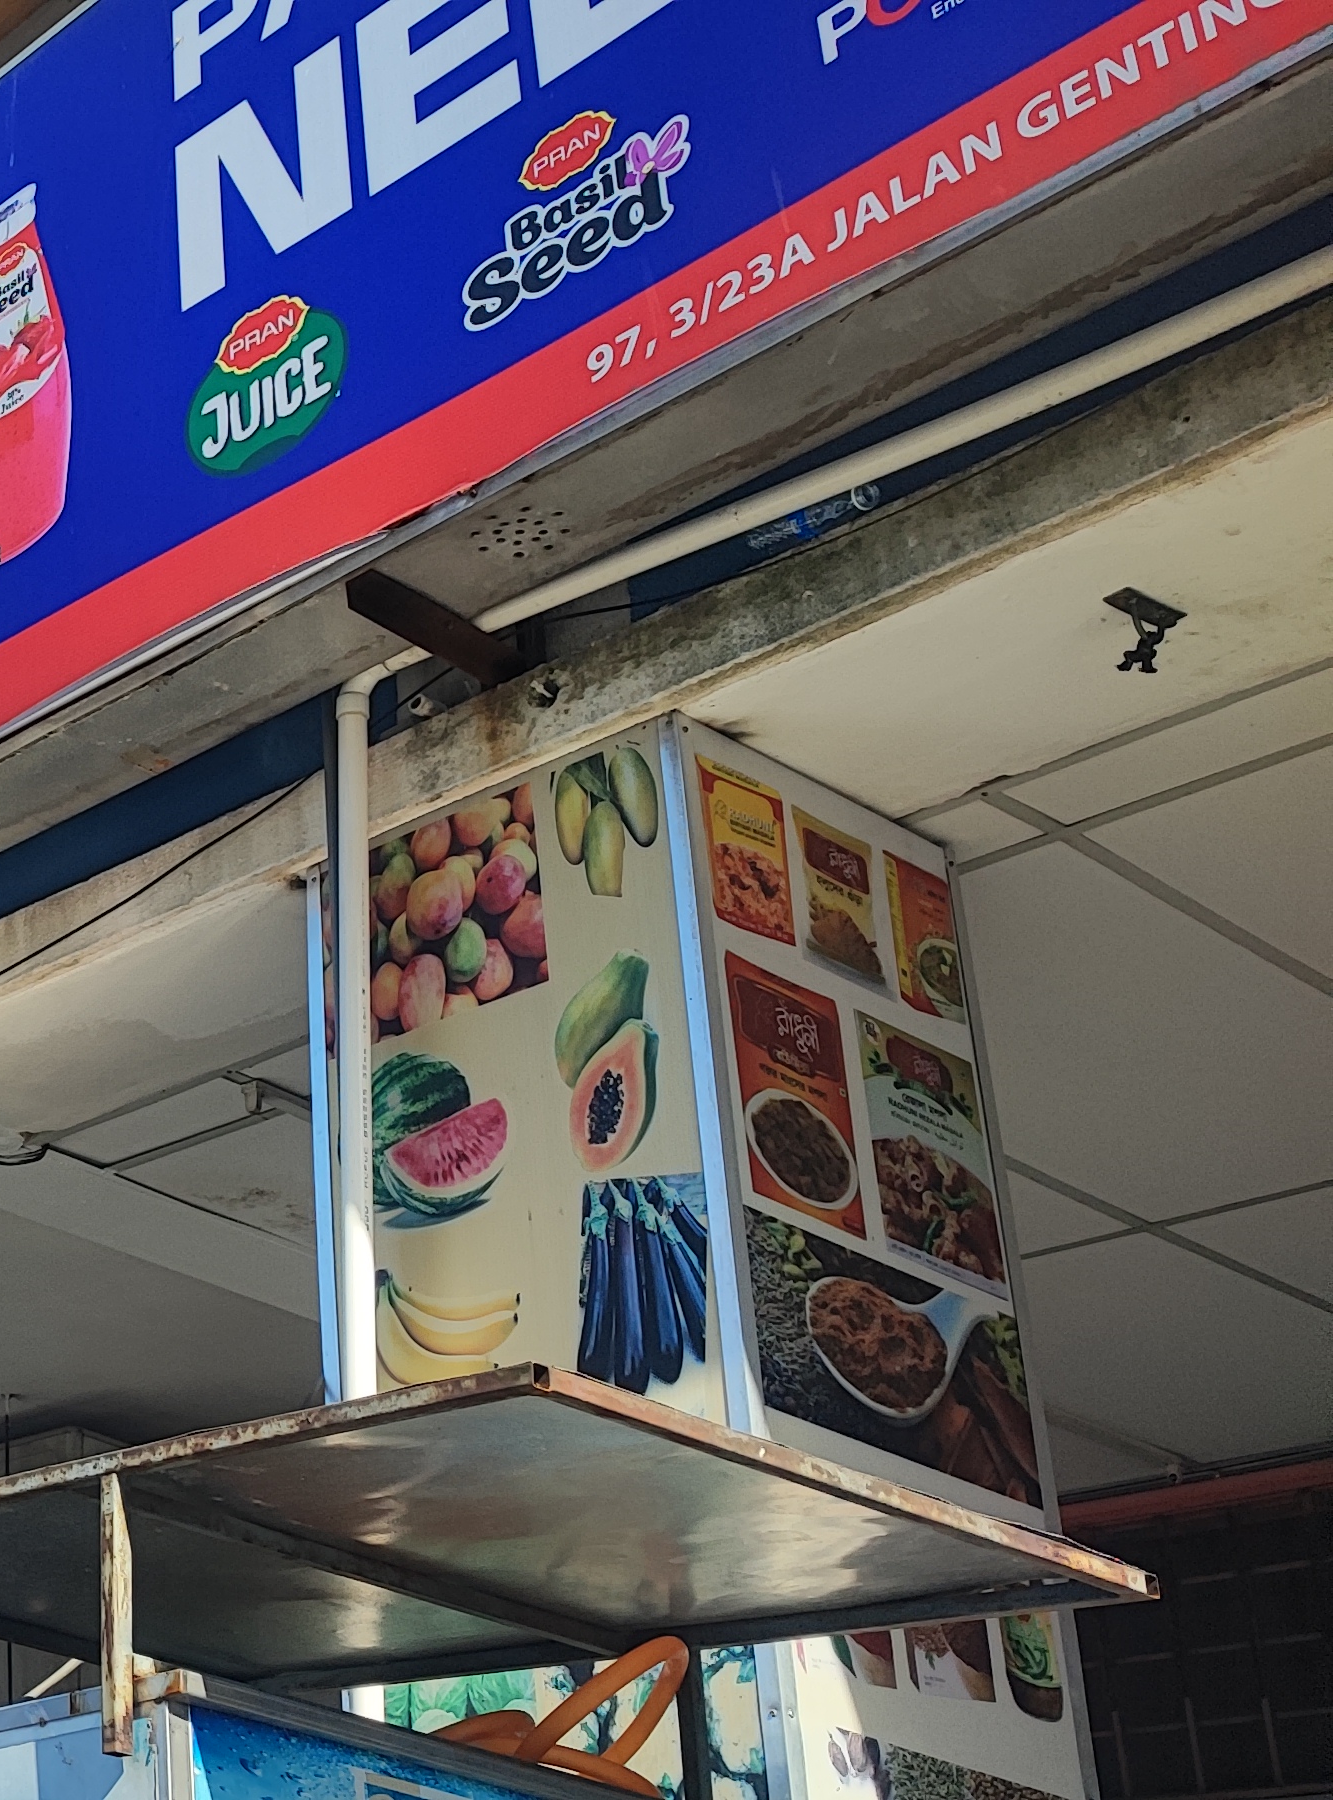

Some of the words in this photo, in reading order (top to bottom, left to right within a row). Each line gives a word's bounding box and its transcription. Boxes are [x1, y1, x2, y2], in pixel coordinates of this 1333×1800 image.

[509, 155, 629, 251] Basil
[533, 123, 601, 178] PRAN
[586, 327, 657, 383] 97,
[669, 233, 815, 338] 3/23A
[827, 121, 1003, 252] JALAN
[1017, 0, 1284, 138] GENTIN
[467, 170, 668, 325] Seed
[228, 309, 295, 360] PRAN
[200, 334, 332, 459] JUICE
